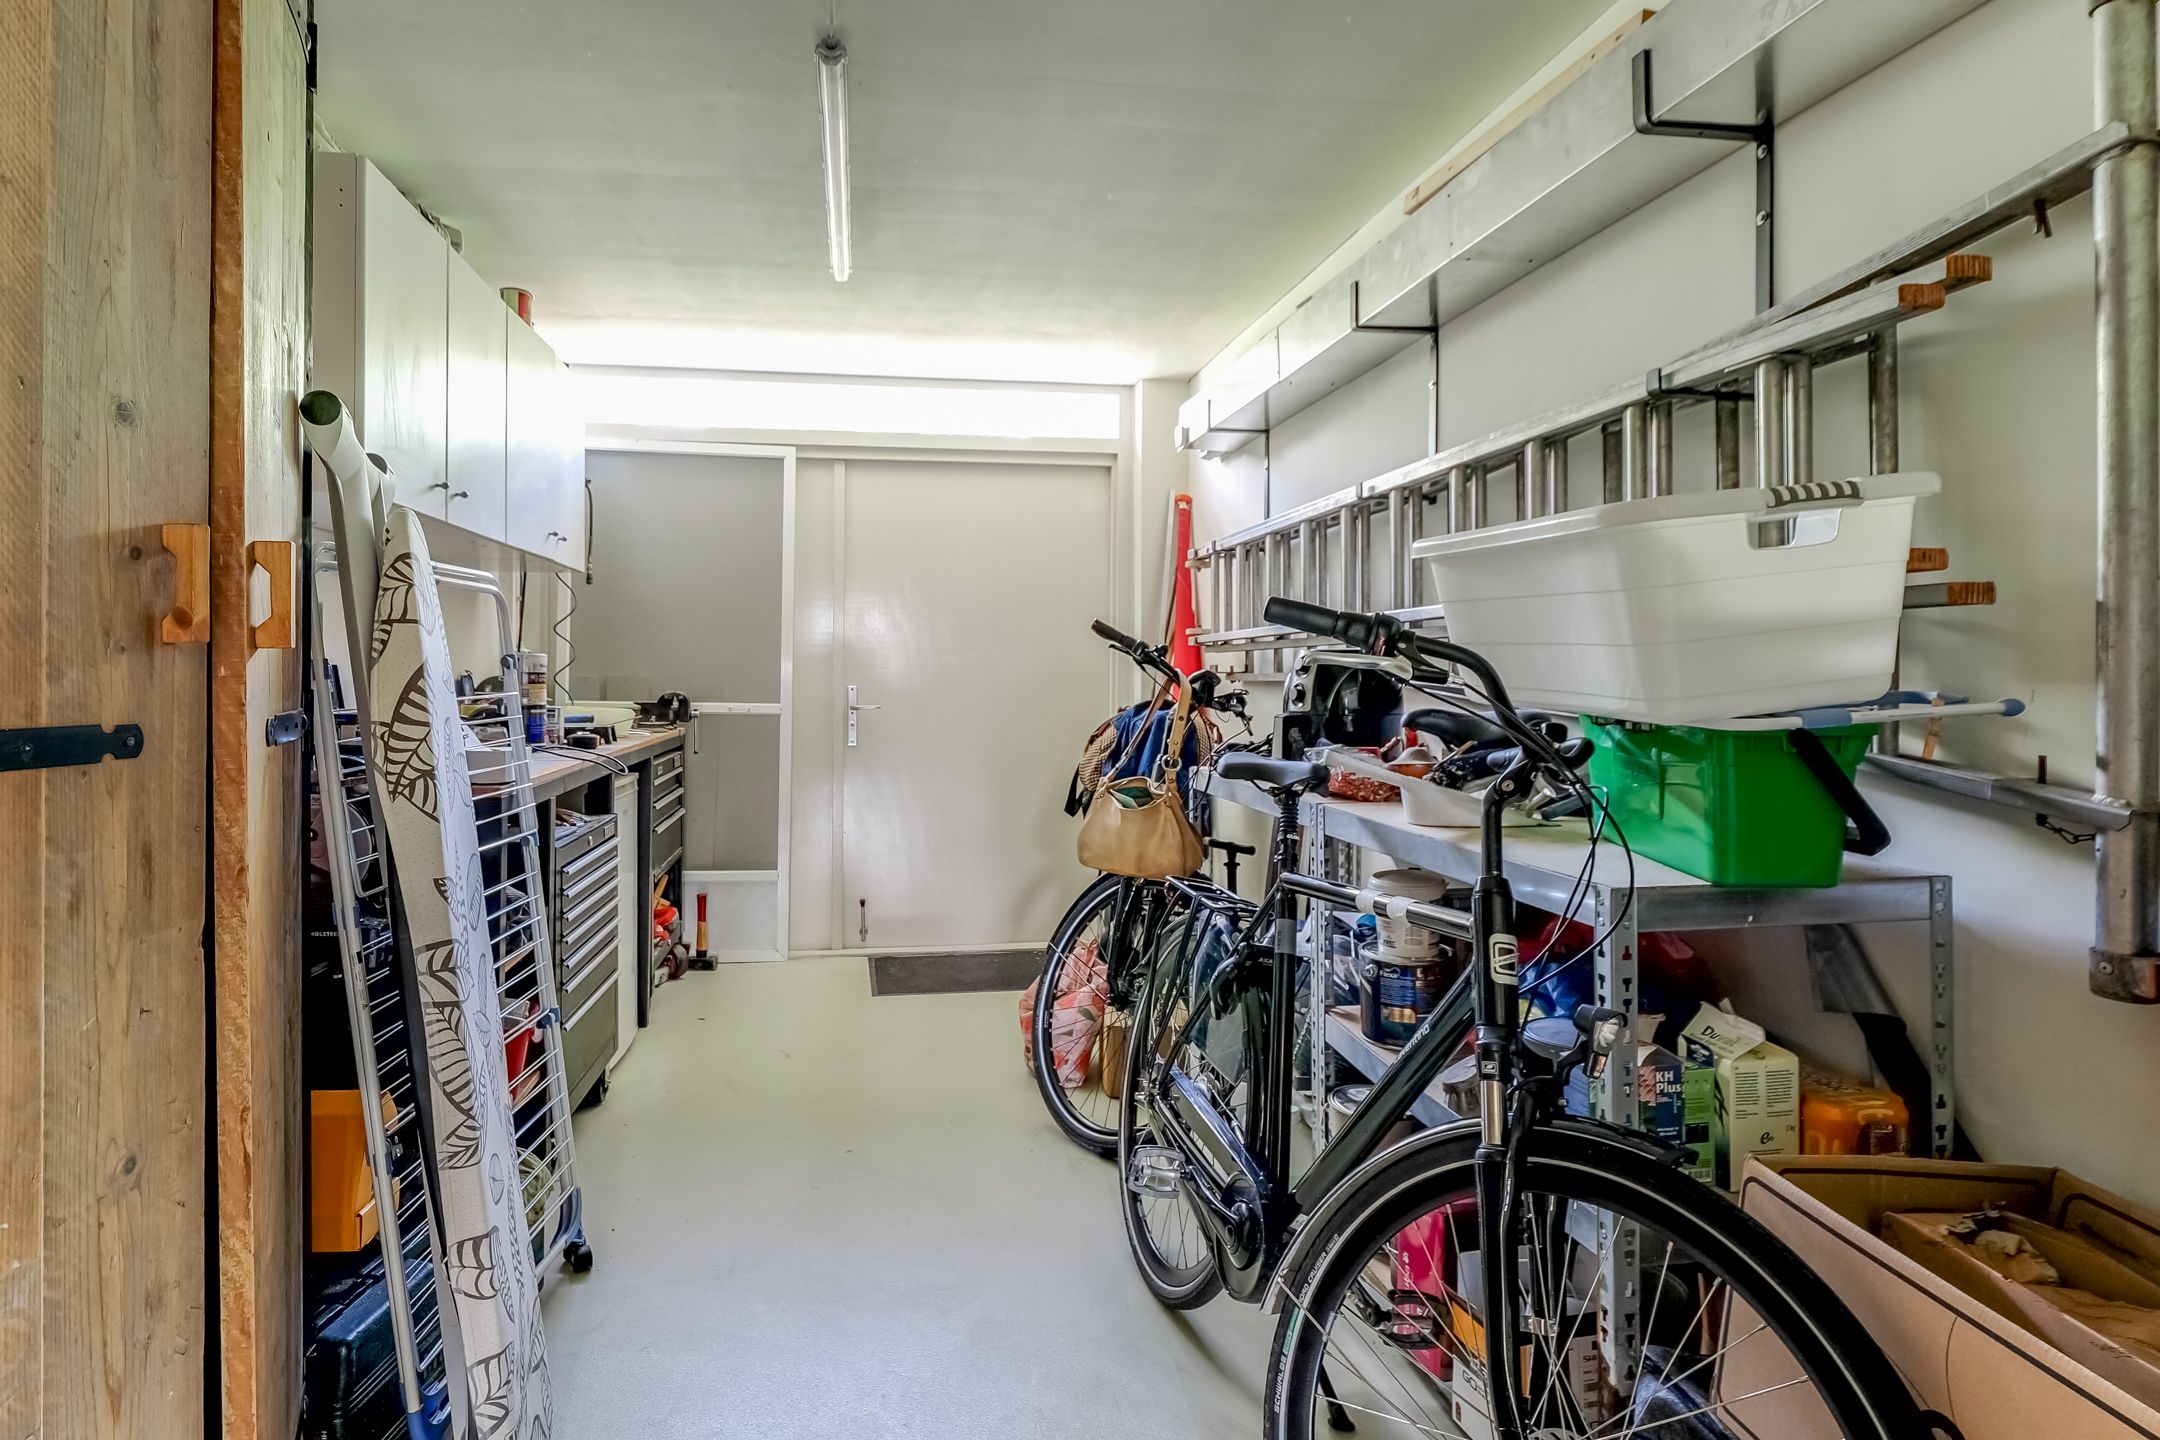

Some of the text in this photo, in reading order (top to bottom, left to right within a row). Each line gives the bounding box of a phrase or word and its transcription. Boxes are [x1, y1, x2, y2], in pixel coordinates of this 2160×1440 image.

[1655, 1070, 1674, 1082] KH
[1655, 1082, 1681, 1094] Plus
[1273, 1355, 1287, 1413] SCHWALBE
[1307, 1251, 1327, 1283] CRUISER
